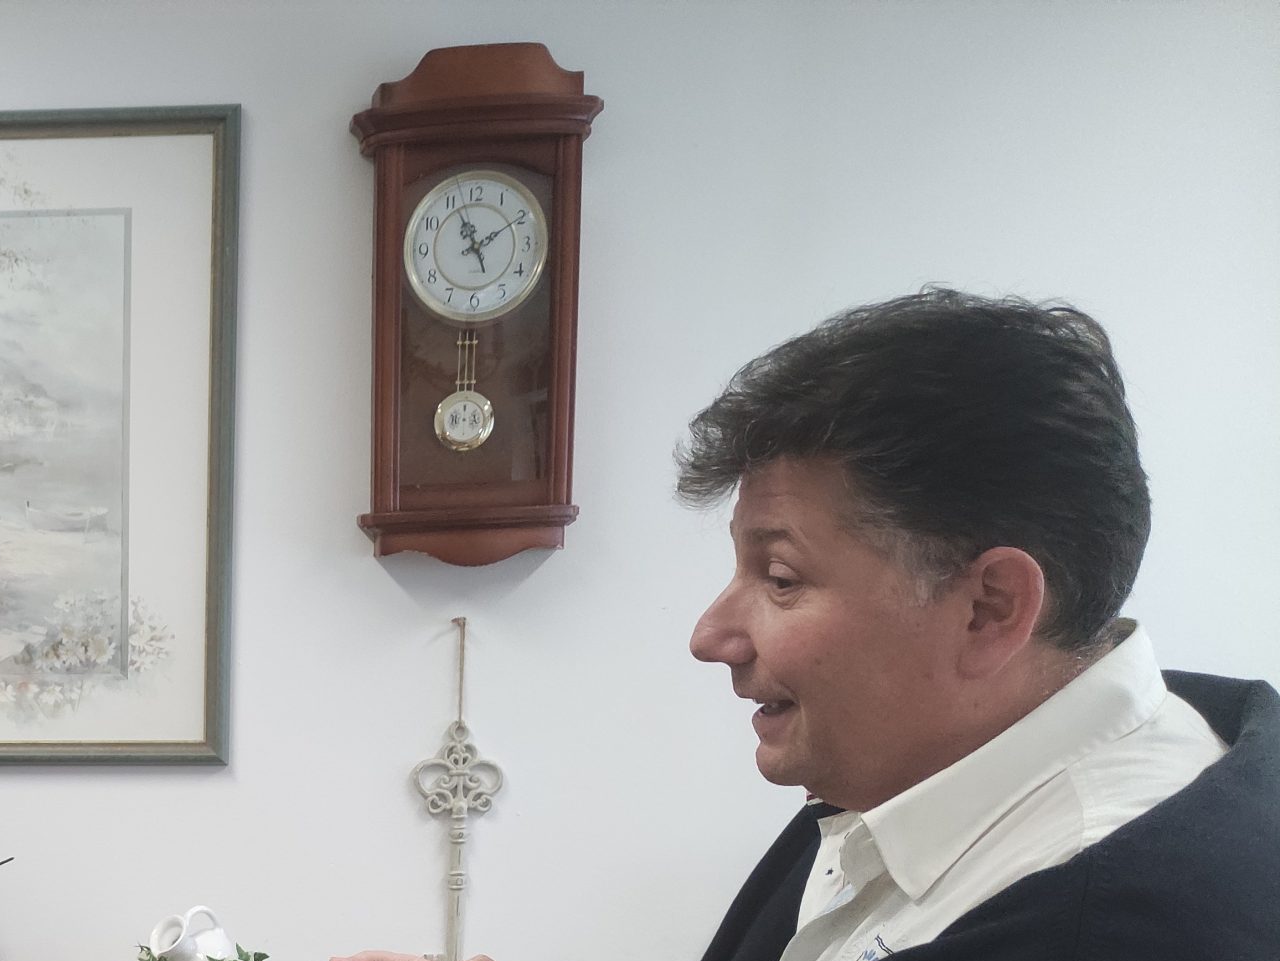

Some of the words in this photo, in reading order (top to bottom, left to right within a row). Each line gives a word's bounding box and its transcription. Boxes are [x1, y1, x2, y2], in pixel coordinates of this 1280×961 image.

[469, 186, 483, 202] 12
[446, 195, 455, 209] 11
[425, 216, 439, 231] 10
[516, 209, 526, 225] 2
[418, 242, 429, 259] 9
[522, 236, 531, 252] 3
[427, 269, 437, 284] 8
[513, 262, 523, 277] 4
[445, 288, 454, 303] 7
[498, 284, 506, 299] 5
[470, 293, 480, 311] 6
